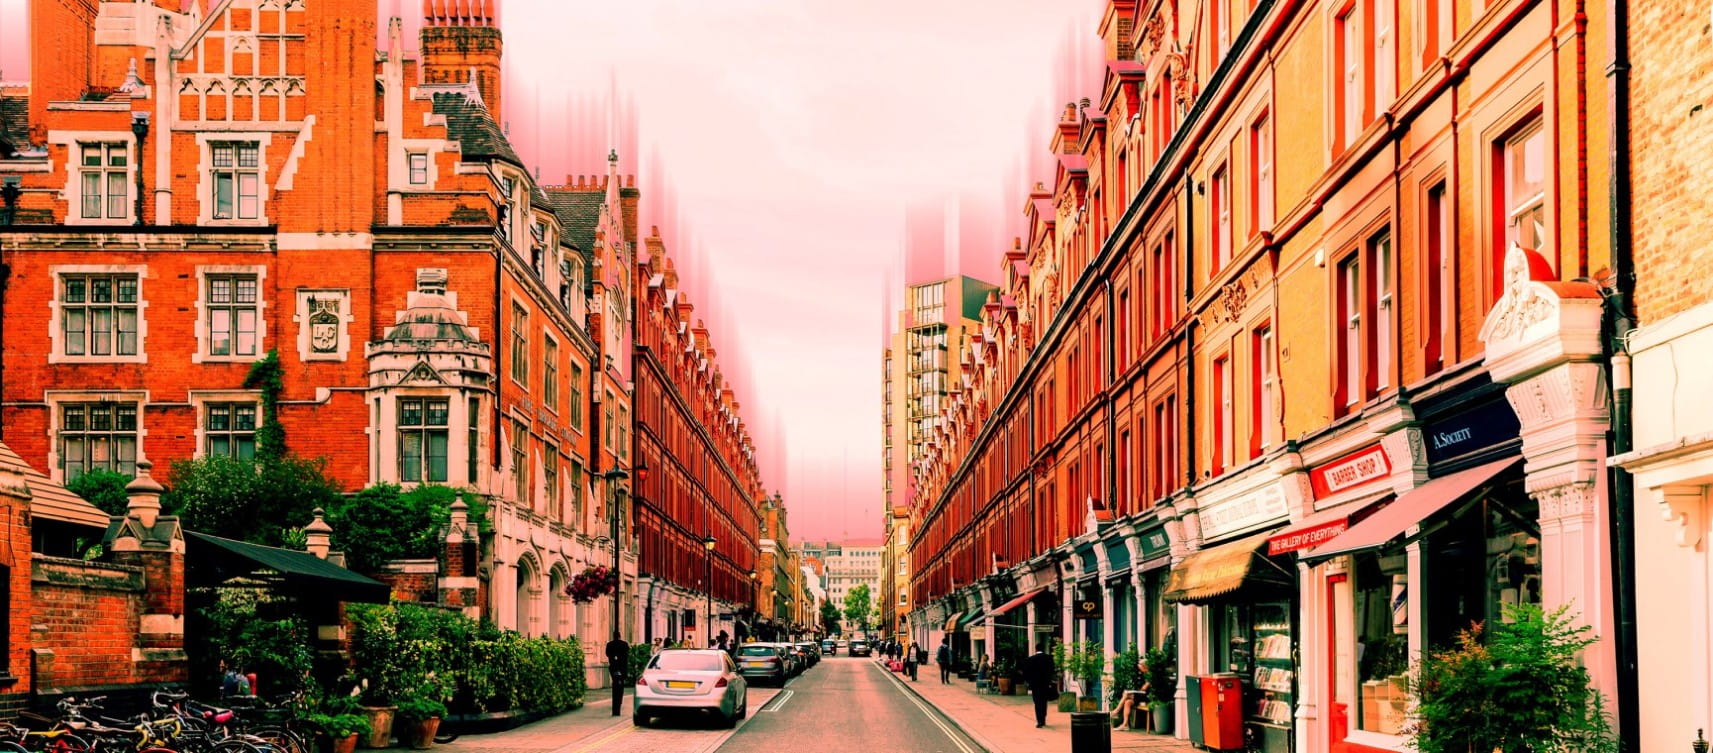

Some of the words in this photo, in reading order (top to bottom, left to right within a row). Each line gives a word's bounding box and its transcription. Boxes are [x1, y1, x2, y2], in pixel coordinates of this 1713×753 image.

[1332, 465, 1357, 486] BARBER
[1356, 458, 1376, 477] SHOP
[1270, 539, 1280, 551] THE
[1281, 533, 1301, 549] GALLERY
[1302, 532, 1311, 545] OF
